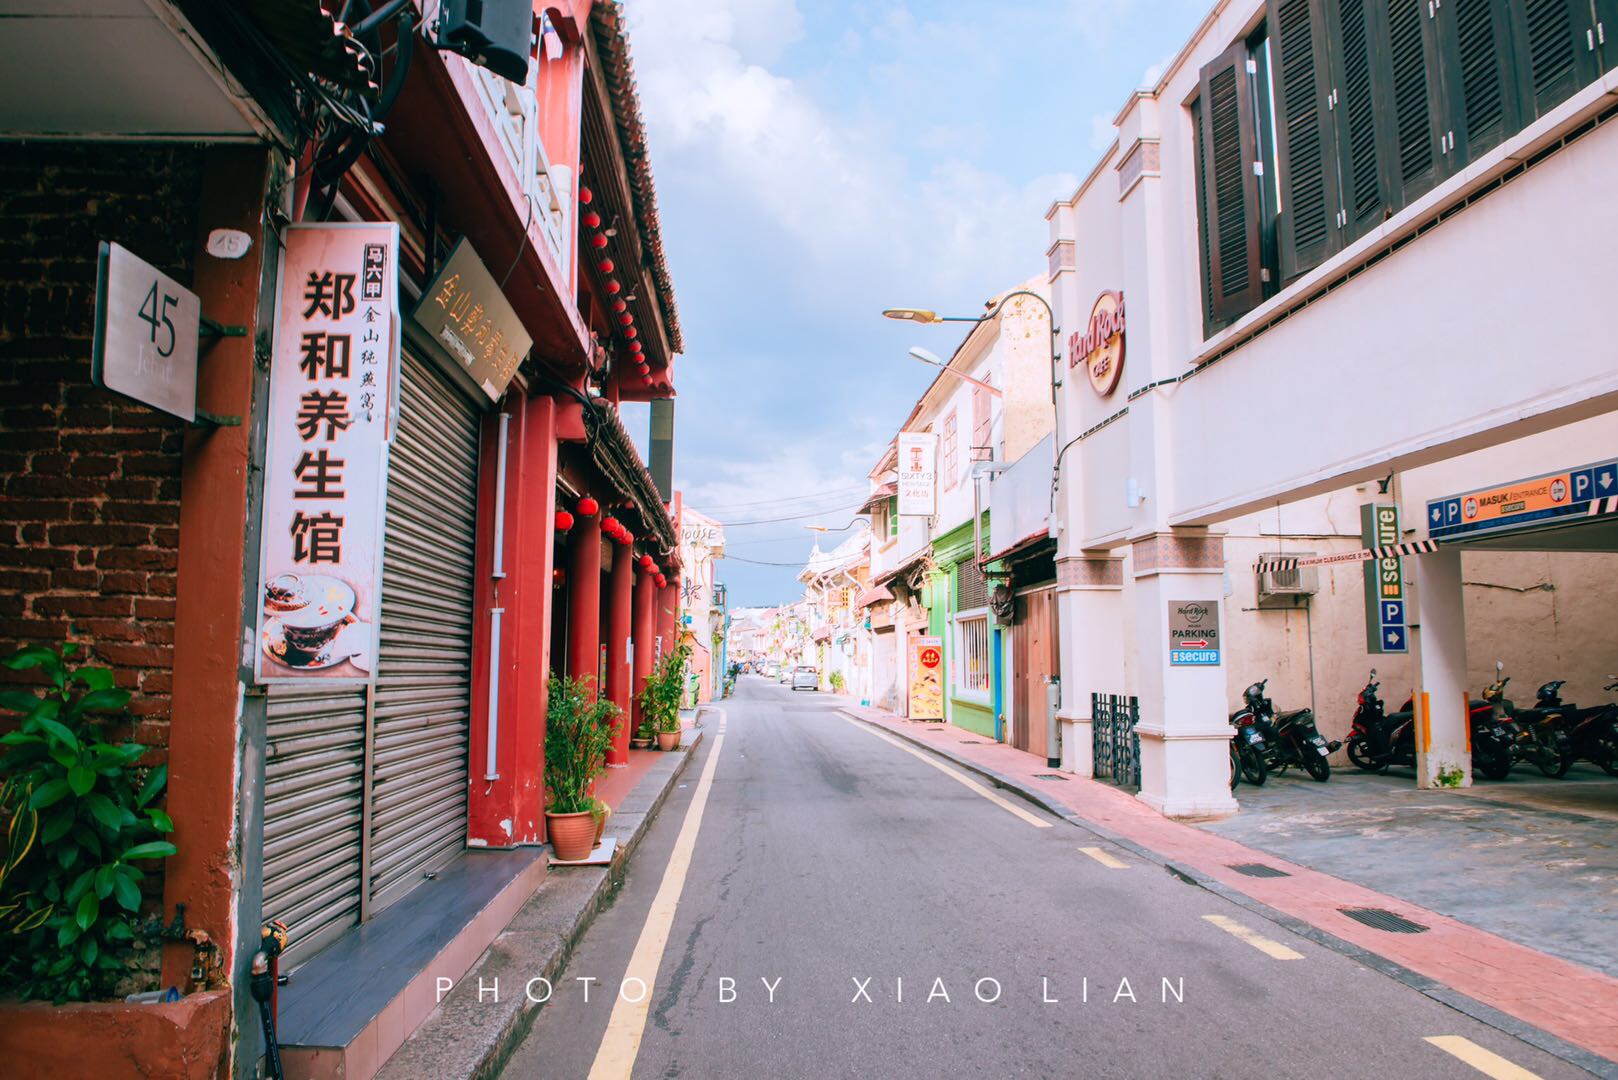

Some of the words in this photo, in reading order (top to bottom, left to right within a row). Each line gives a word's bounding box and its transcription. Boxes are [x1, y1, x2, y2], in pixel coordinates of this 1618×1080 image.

[215, 234, 241, 252] 45
[366, 246, 384, 298] 马六甲
[138, 280, 179, 358] 45
[1068, 315, 1097, 369] Hard
[1095, 291, 1126, 349] Rock
[290, 271, 358, 566] 郑和养生馆
[1479, 492, 1509, 507] MASUK
[1380, 510, 1399, 582] seure
[1172, 630, 1216, 638] PARKING
[1180, 651, 1217, 662] secure
